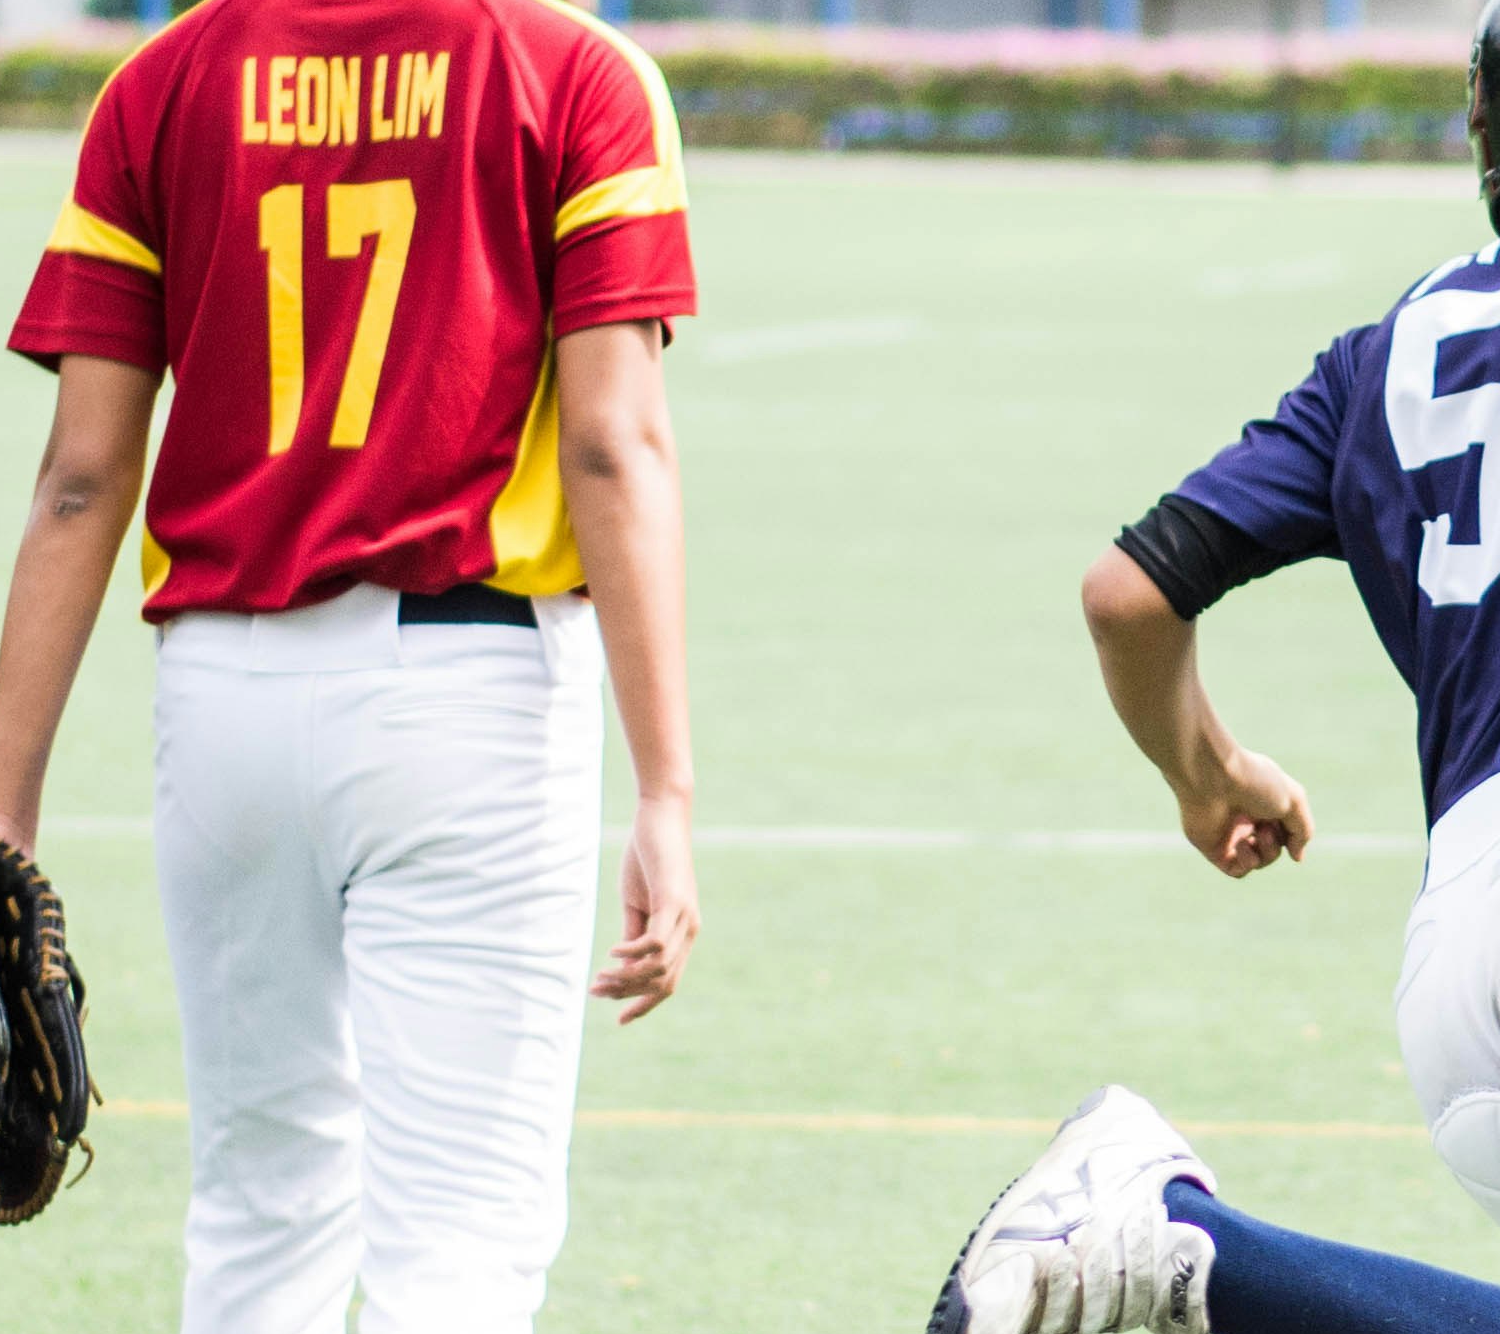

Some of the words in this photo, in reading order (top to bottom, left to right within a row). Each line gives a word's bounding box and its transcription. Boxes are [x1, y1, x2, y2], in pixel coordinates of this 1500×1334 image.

[243, 55, 362, 147] LEON
[370, 51, 451, 143] LIM
[259, 178, 417, 456] 17
